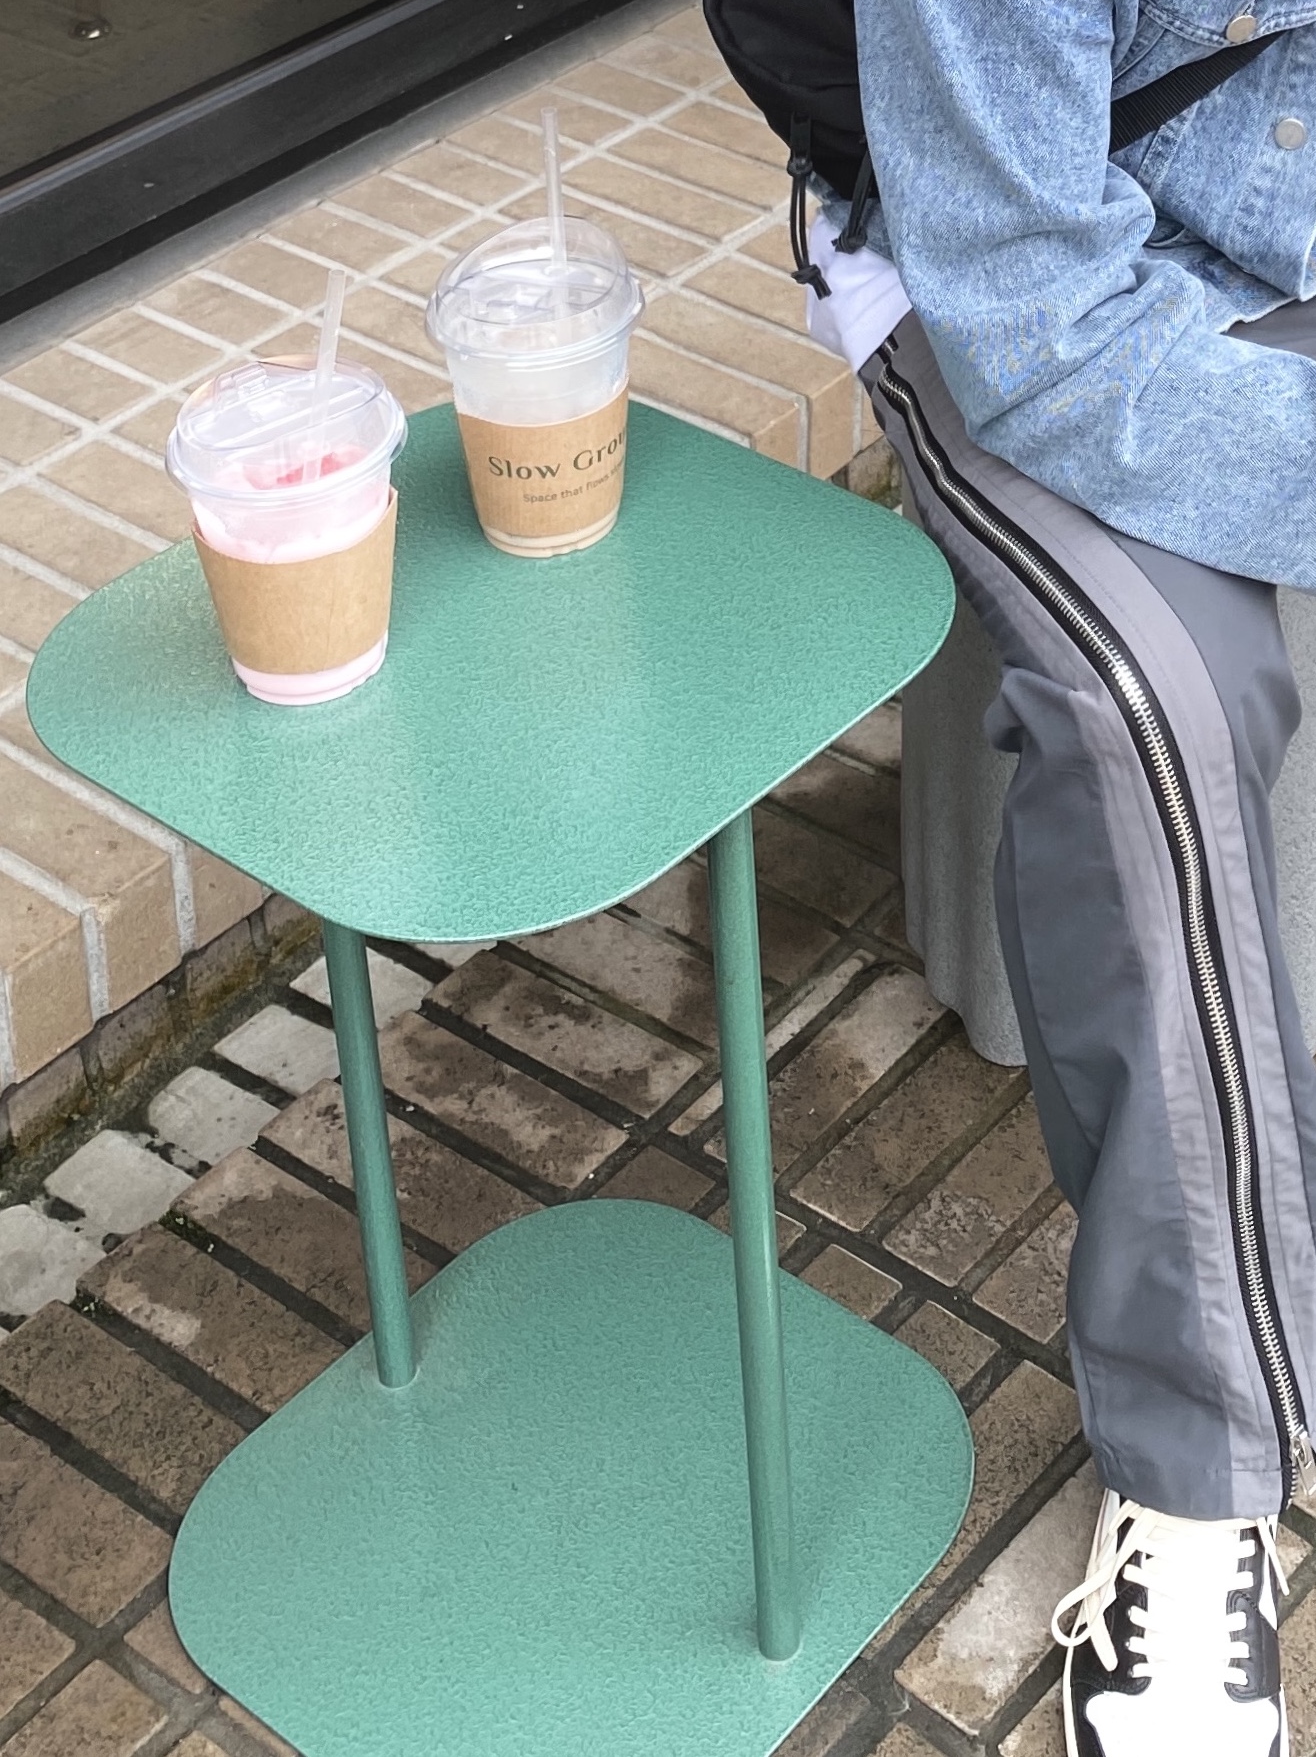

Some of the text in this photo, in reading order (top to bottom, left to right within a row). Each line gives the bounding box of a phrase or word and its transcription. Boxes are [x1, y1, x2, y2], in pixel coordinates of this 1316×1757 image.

[488, 456, 560, 480] Slow
[523, 493, 557, 504] Space
[561, 486, 583, 499] that
